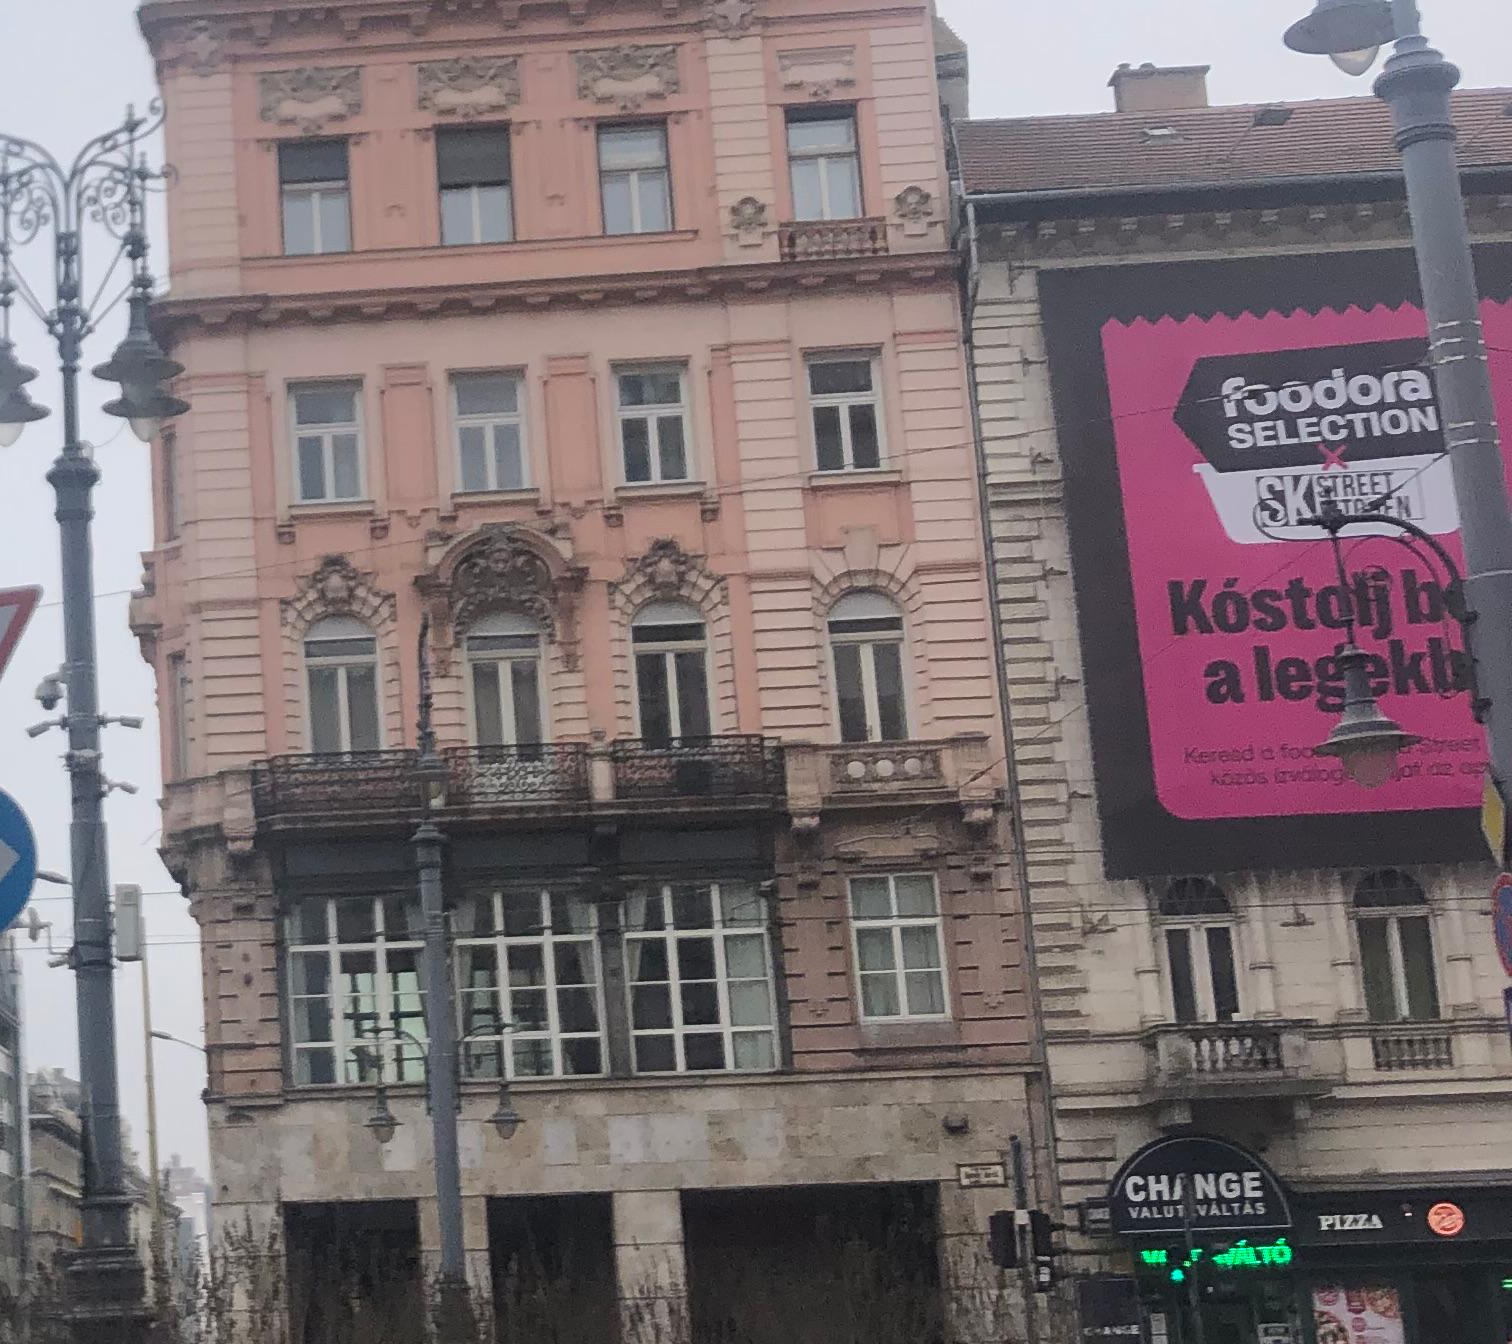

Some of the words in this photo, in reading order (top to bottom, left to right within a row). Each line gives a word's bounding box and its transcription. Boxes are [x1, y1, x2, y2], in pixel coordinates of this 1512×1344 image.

[1221, 368, 1433, 419] foodora
[1227, 406, 1440, 449] SELECTION
[1316, 472, 1393, 498] STREET
[1167, 568, 1393, 640] Kóstolj
[1203, 658, 1245, 705] a
[1319, 1213, 1383, 1231] PIZZA
